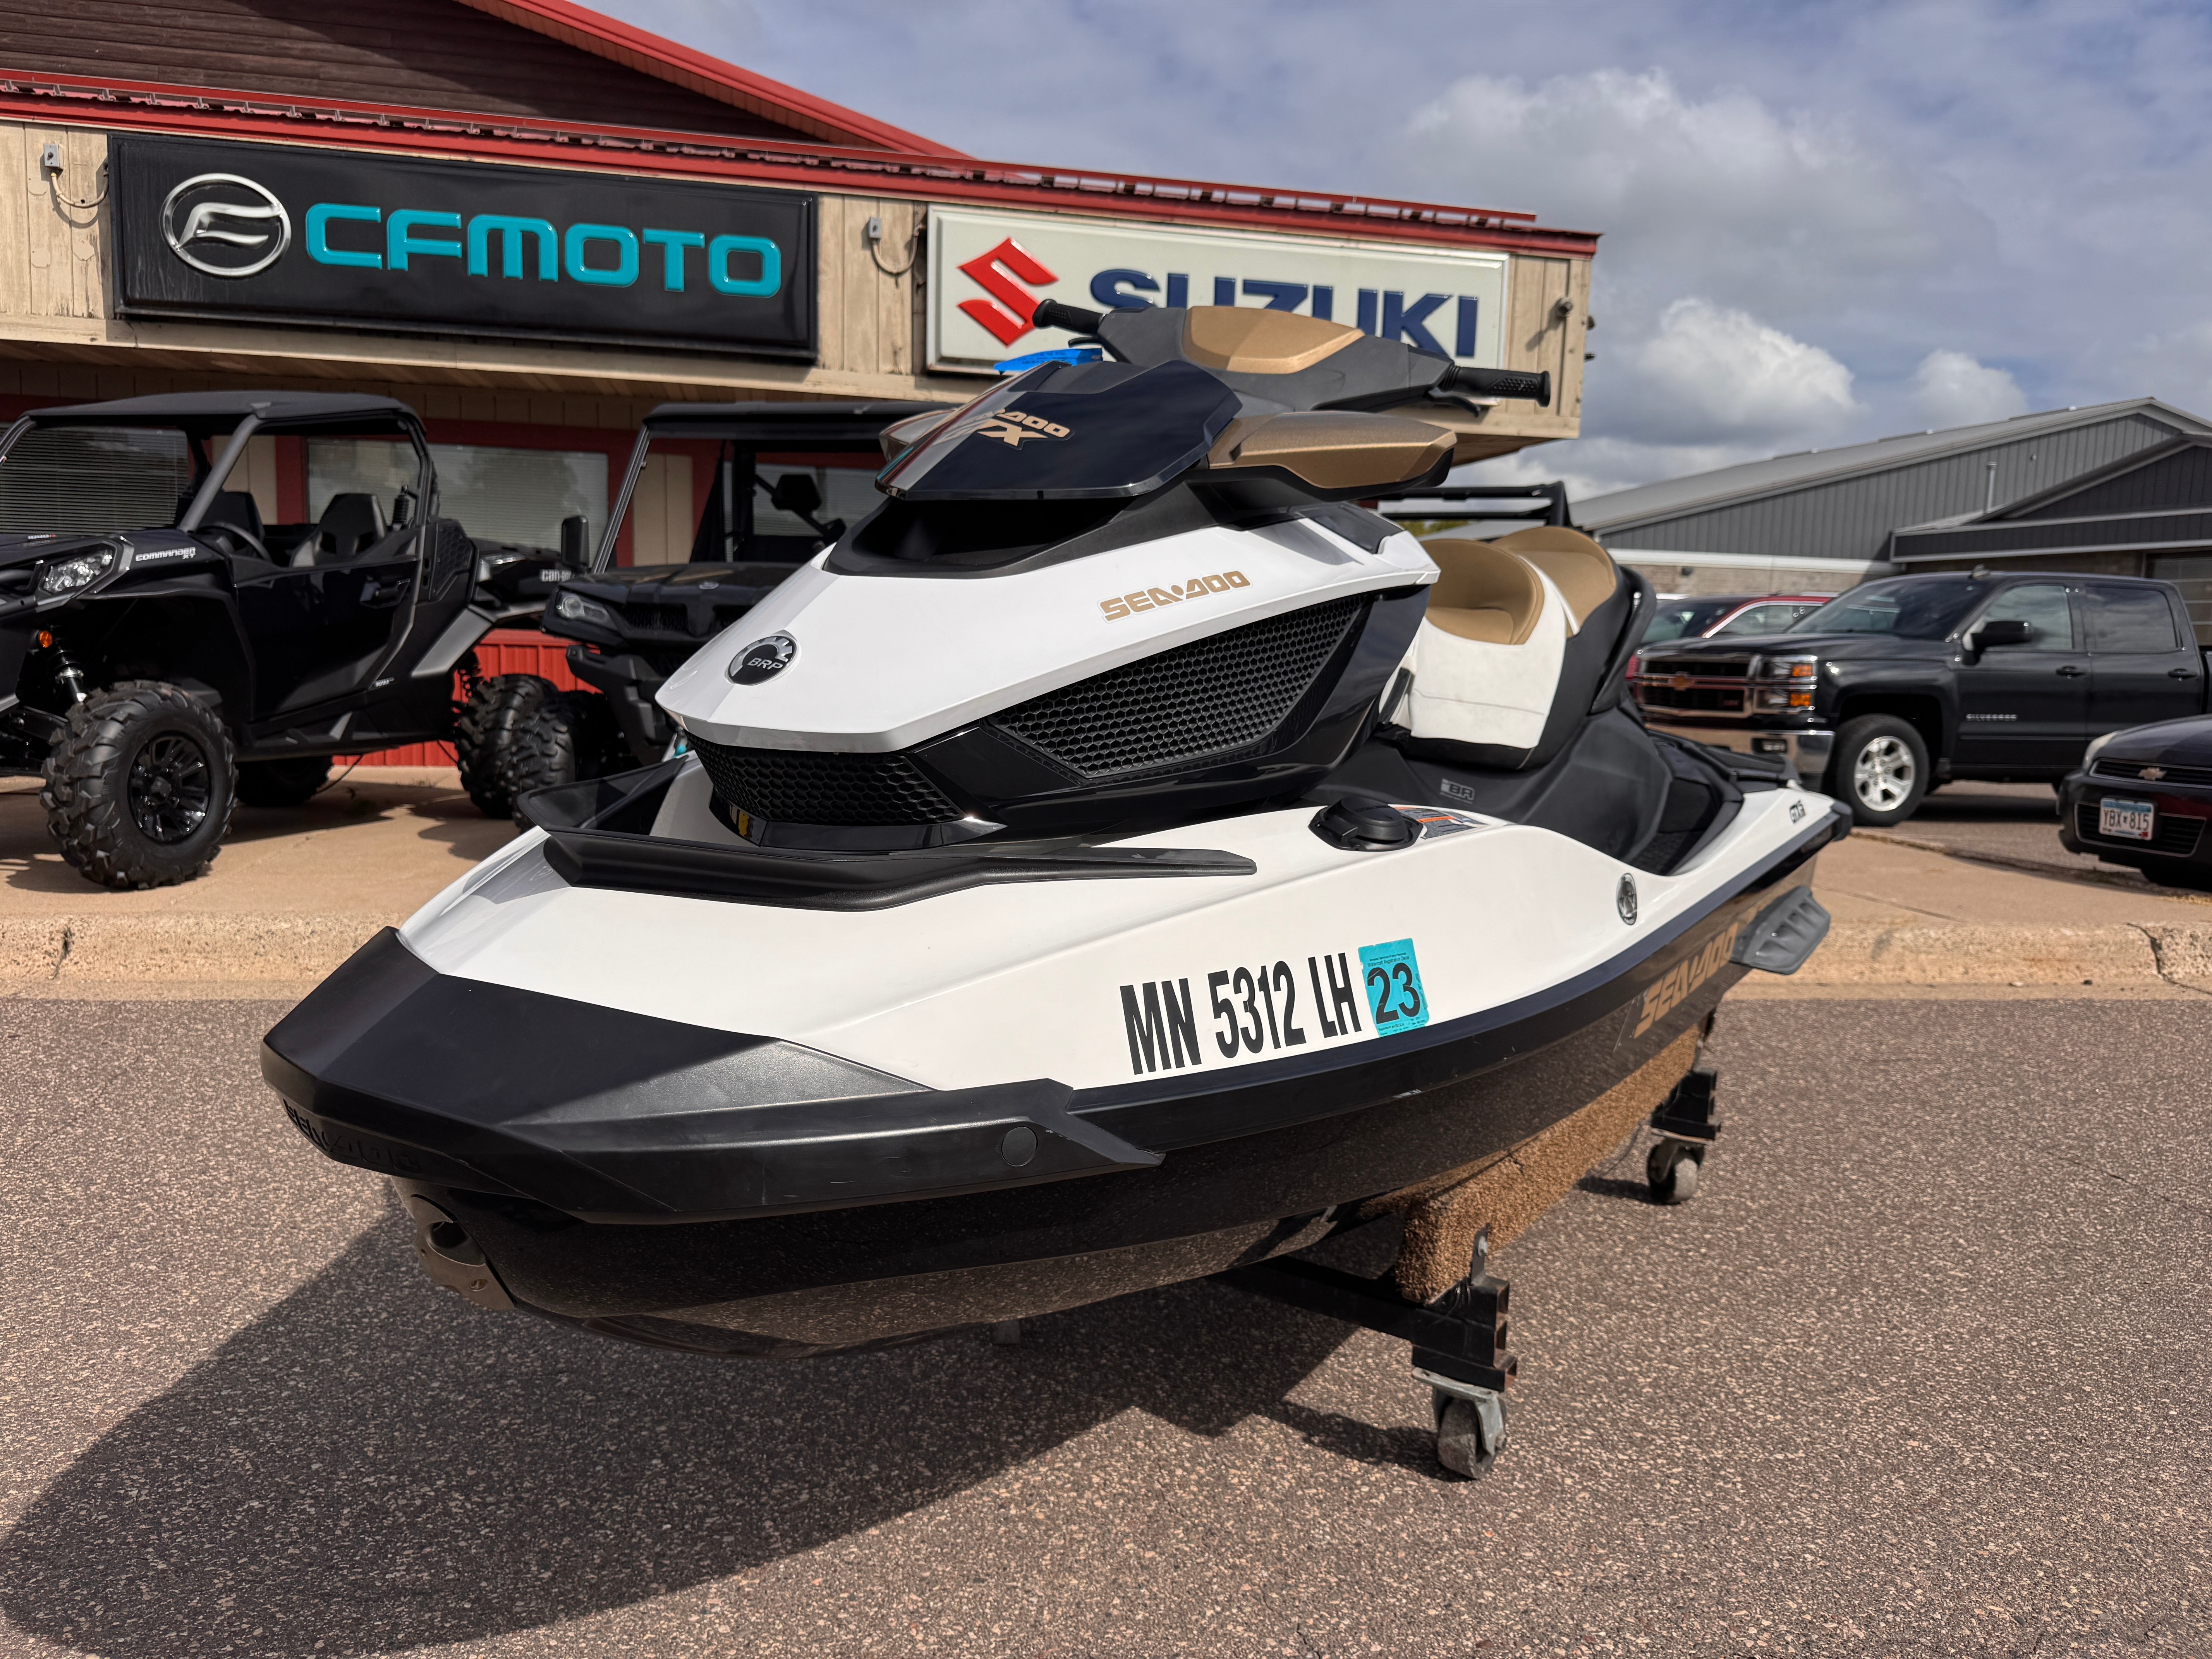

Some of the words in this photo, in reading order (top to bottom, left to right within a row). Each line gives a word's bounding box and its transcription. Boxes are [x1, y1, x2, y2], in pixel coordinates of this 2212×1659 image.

[305, 202, 781, 298] CFMOTO
[136, 546, 196, 562] COMMANDER
[747, 657, 783, 671] BRP
[1120, 978, 1202, 1075] MN
[1207, 960, 1307, 1059] 5312
[1307, 953, 1362, 1038] LH
[1367, 962, 1420, 1024] 23
